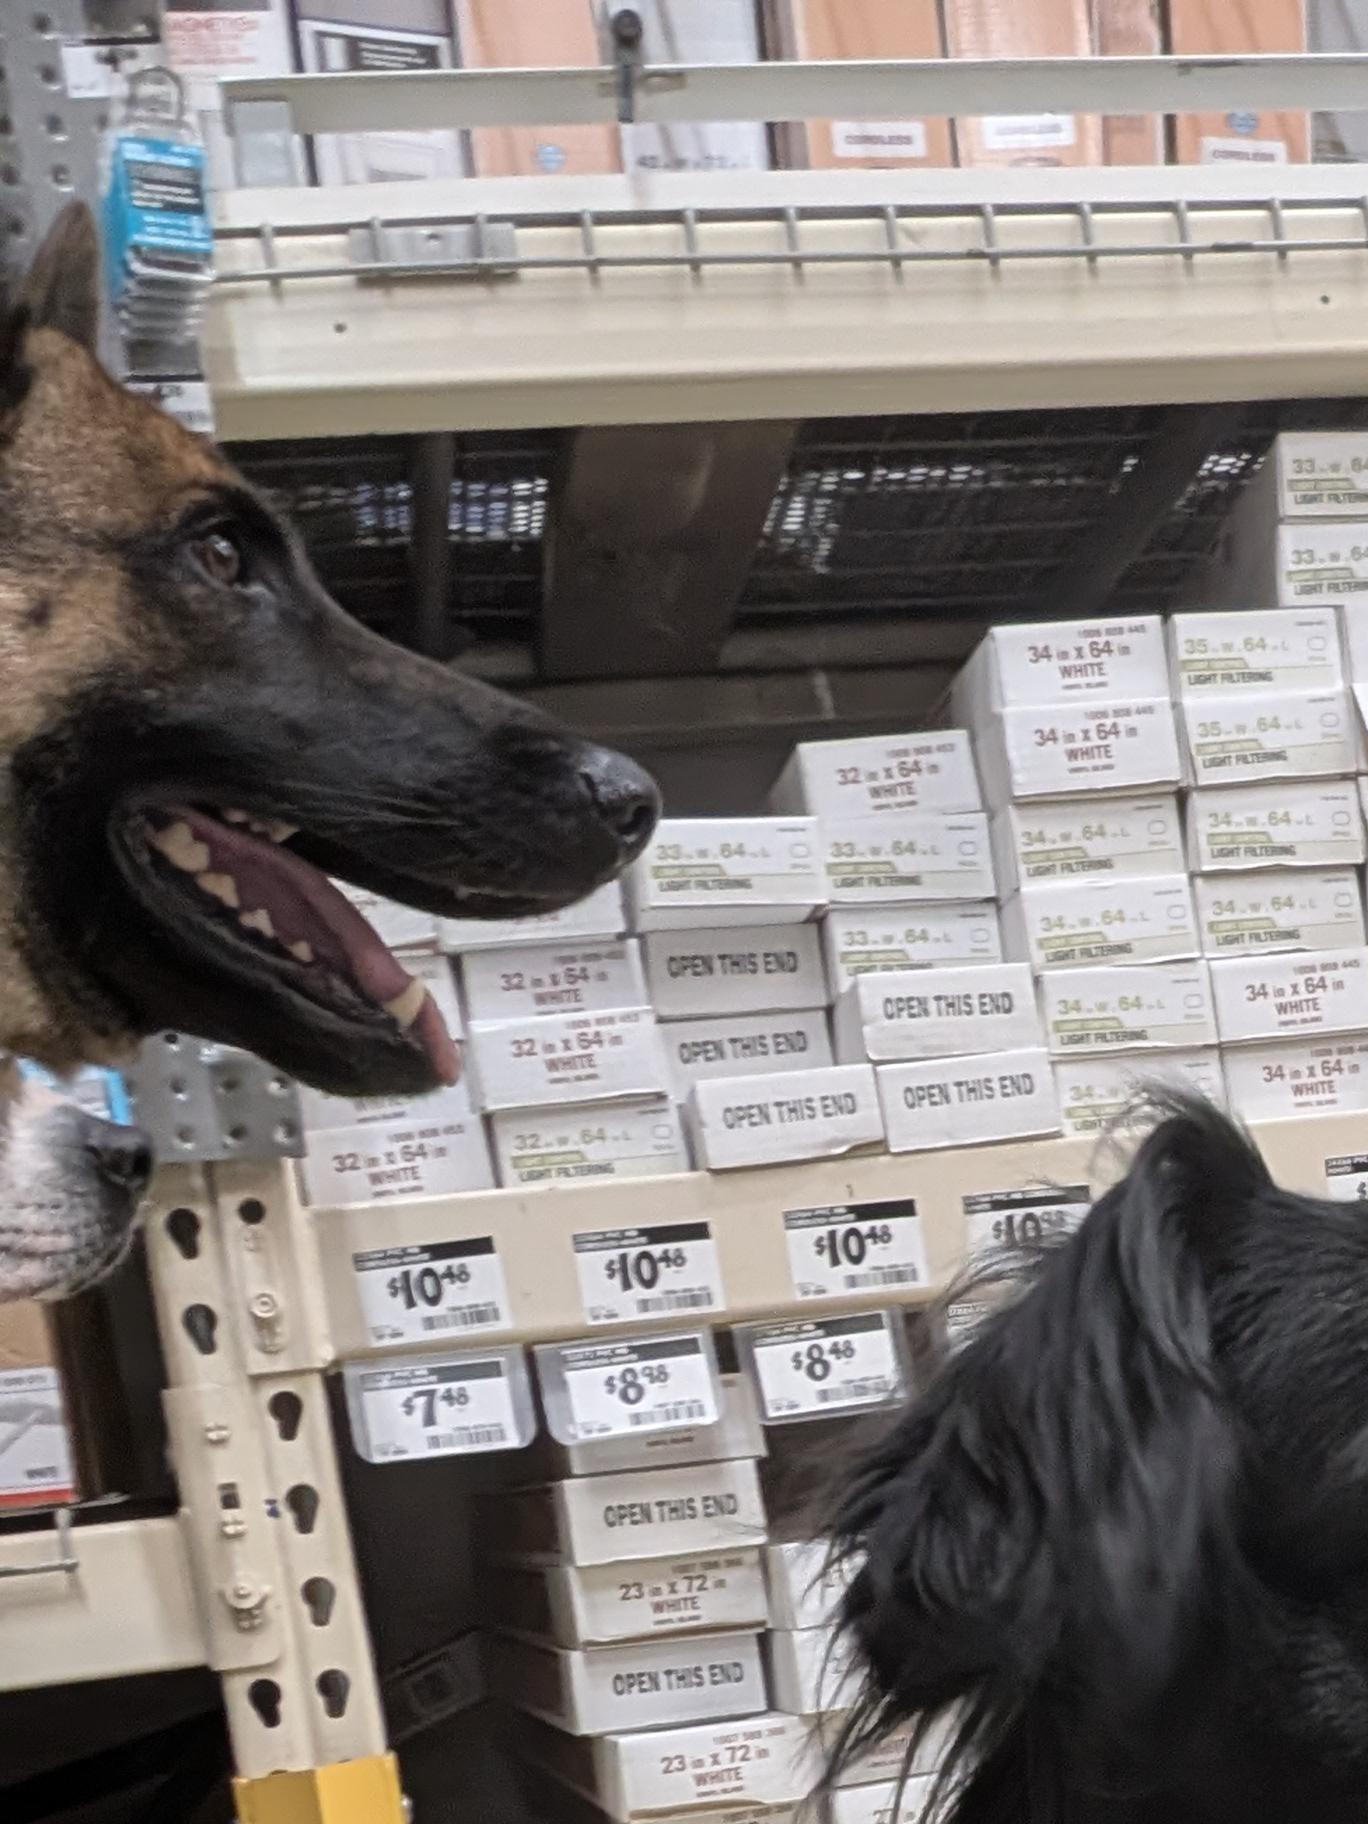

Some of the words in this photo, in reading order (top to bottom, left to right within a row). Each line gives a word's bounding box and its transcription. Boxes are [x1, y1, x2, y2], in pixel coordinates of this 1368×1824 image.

[1294, 493, 1325, 504] LIGHT
[1059, 663, 1106, 678] WHITE
[1188, 674, 1217, 685] LIGHT
[1220, 672, 1273, 682] FILTERING
[1034, 729, 1059, 746] 34
[1063, 728, 1075, 741] in
[1096, 722, 1120, 740] 64
[1126, 725, 1137, 737] in
[1065, 745, 1113, 761] WHITE
[1211, 847, 1242, 858] LIGHT
[1245, 845, 1295, 856] FILTERING
[1217, 934, 1247, 945] LIGHT
[1249, 931, 1299, 942] FILTERING
[667, 956, 713, 978] OPEN
[718, 953, 758, 974] THIS
[764, 951, 797, 973] END
[1245, 984, 1268, 1001] 34
[1273, 985, 1285, 998] in
[1304, 976, 1327, 993] 64
[1332, 979, 1344, 990] in
[884, 997, 930, 1020] OPEN
[934, 994, 973, 1016] THIS
[978, 992, 1014, 1015] END
[1275, 998, 1320, 1015] WHITE
[511, 1039, 536, 1058] 32
[542, 1041, 555, 1053] in
[577, 1031, 602, 1048] 64
[610, 1034, 623, 1046] in
[679, 1042, 724, 1063] OPEN
[730, 1037, 769, 1058] THIS
[774, 1031, 807, 1054] END
[1060, 1033, 1091, 1044] LIGHT
[1094, 1030, 1147, 1042] FILTERING
[546, 1054, 597, 1072] WHITE
[904, 1083, 949, 1109] OPEN
[954, 1077, 994, 1102] THIS
[999, 1073, 1034, 1097] END
[722, 1106, 770, 1129] OPEN
[775, 1100, 818, 1123] THIS
[822, 1095, 856, 1118] END
[604, 1502, 651, 1527] OPEN
[656, 1498, 697, 1522] THIS
[702, 1494, 737, 1517] END
[613, 1672, 659, 1695] OPEN
[664, 1666, 704, 1690] THIS
[709, 1662, 744, 1684] END
[661, 1755, 686, 1773] 23
[691, 1755, 705, 1768] in
[726, 1746, 751, 1763] 72
[756, 1747, 769, 1759] in
[694, 1768, 743, 1785] WHITE
